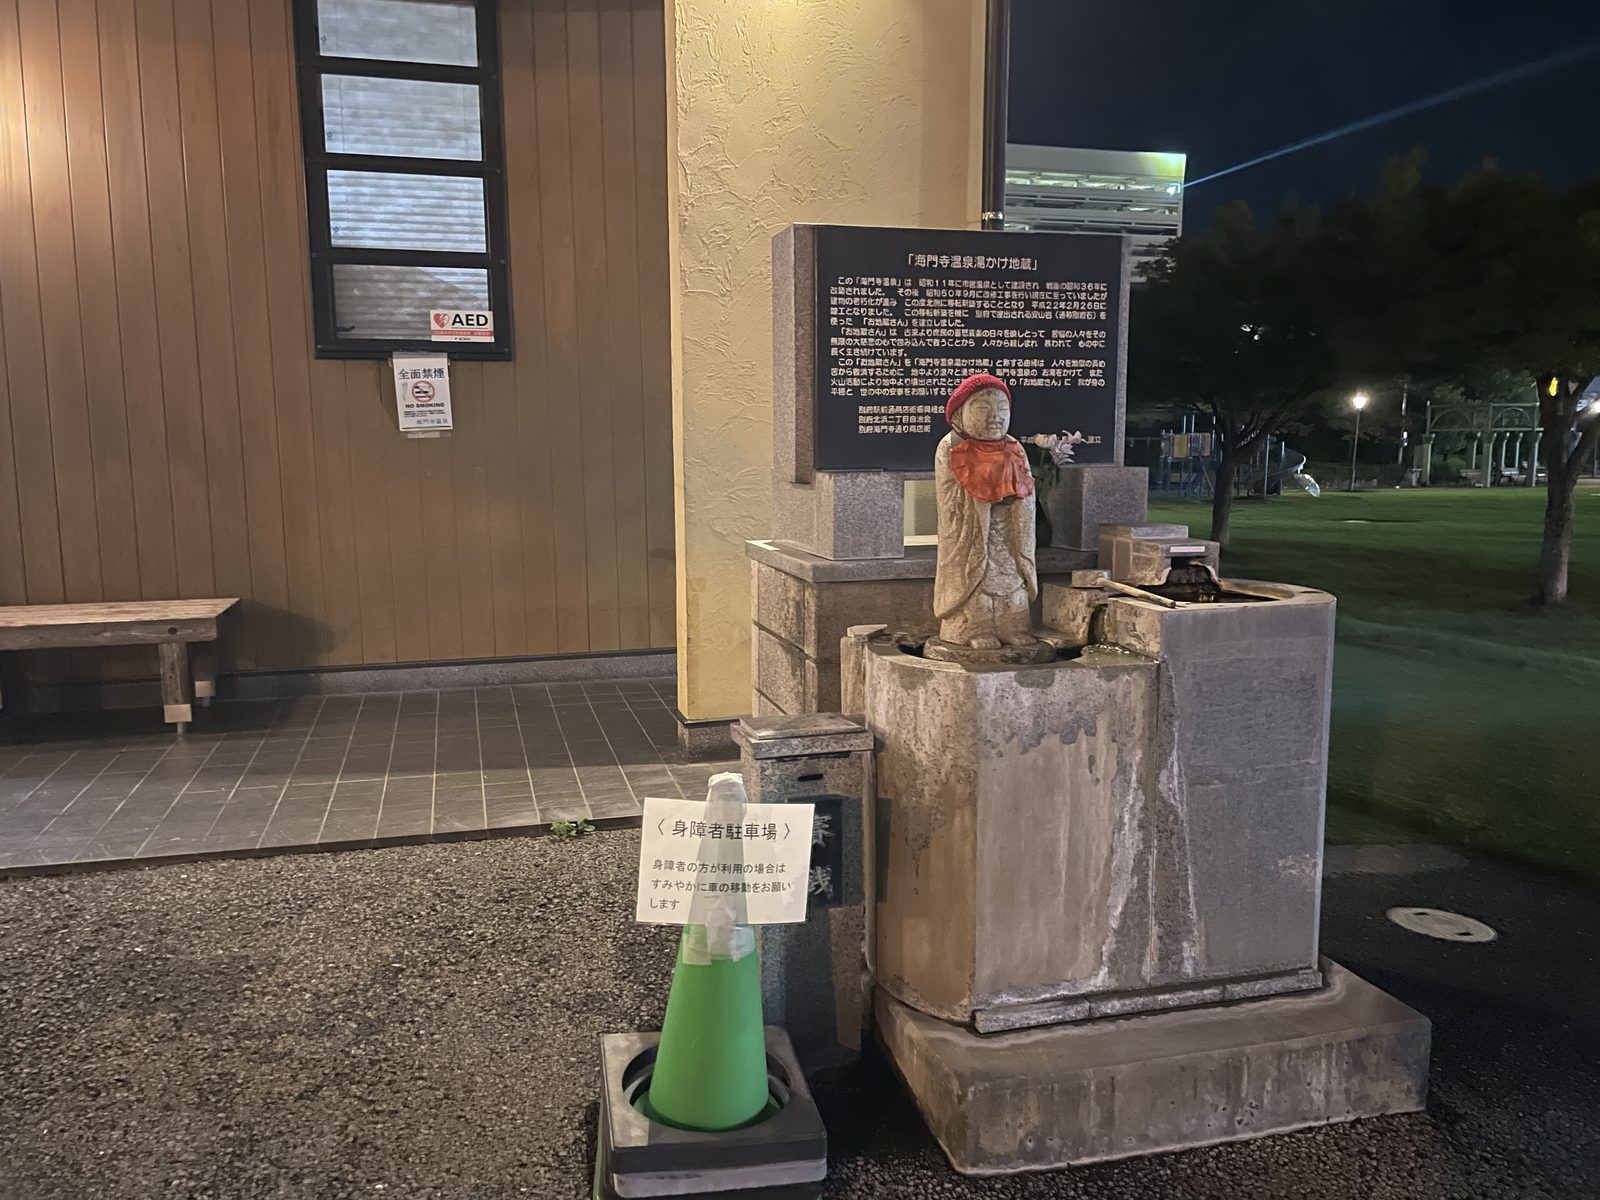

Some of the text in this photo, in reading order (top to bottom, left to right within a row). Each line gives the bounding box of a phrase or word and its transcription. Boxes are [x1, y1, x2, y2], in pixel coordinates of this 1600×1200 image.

[907, 253, 1038, 271] 「海門寺温泉湯かけ地蔵」
[451, 313, 489, 327] AED
[398, 367, 446, 380] 全面禁煙
[652, 859, 786, 875] 身障者の方が利用の場合は
[651, 878, 791, 894] すみやかに車の移動をお願い
[649, 898, 680, 910] します
